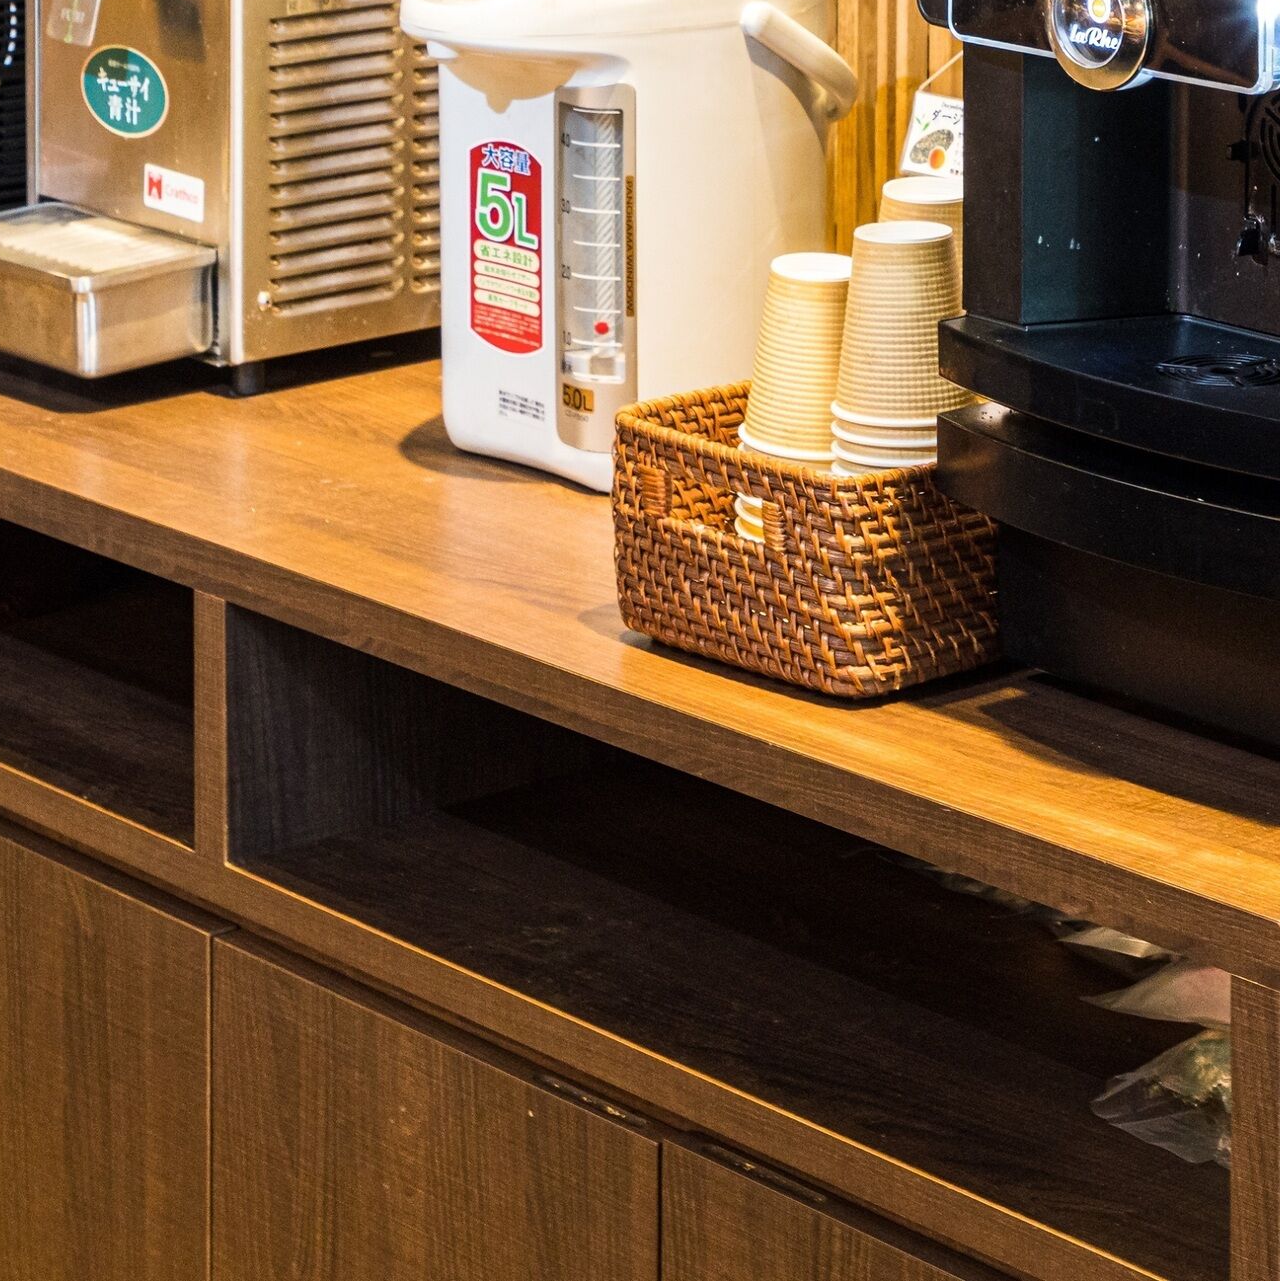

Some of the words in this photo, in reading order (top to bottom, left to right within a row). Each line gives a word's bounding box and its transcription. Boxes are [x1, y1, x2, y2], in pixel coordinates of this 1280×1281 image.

[97, 66, 150, 102] キューサイ
[108, 94, 141, 126] 青汁
[482, 144, 531, 176] 大容量
[476, 169, 539, 250] 5L
[480, 244, 533, 268] 省エネ設計
